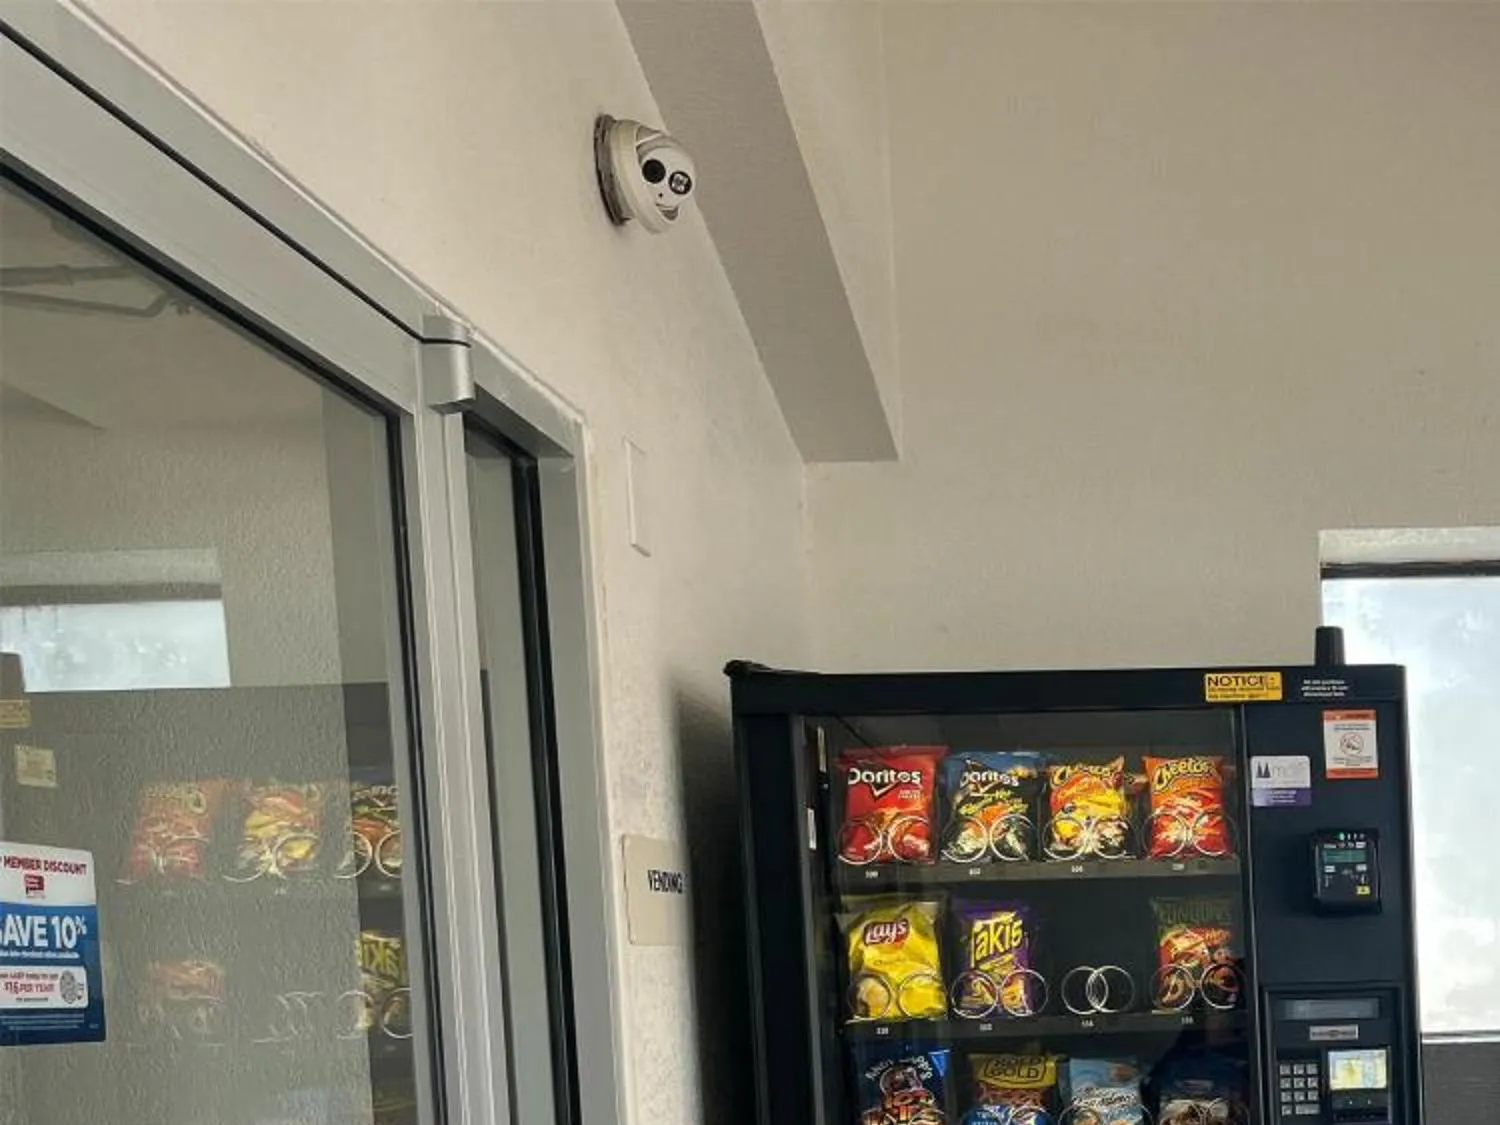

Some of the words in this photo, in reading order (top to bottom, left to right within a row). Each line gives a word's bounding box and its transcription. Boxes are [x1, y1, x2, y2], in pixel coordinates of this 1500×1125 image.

[848, 767, 921, 785] Doritos
[959, 769, 1020, 787] Doritos
[4, 856, 41, 871] MEMBER
[44, 860, 87, 875] DISCOUNT
[0, 913, 48, 947] AVE
